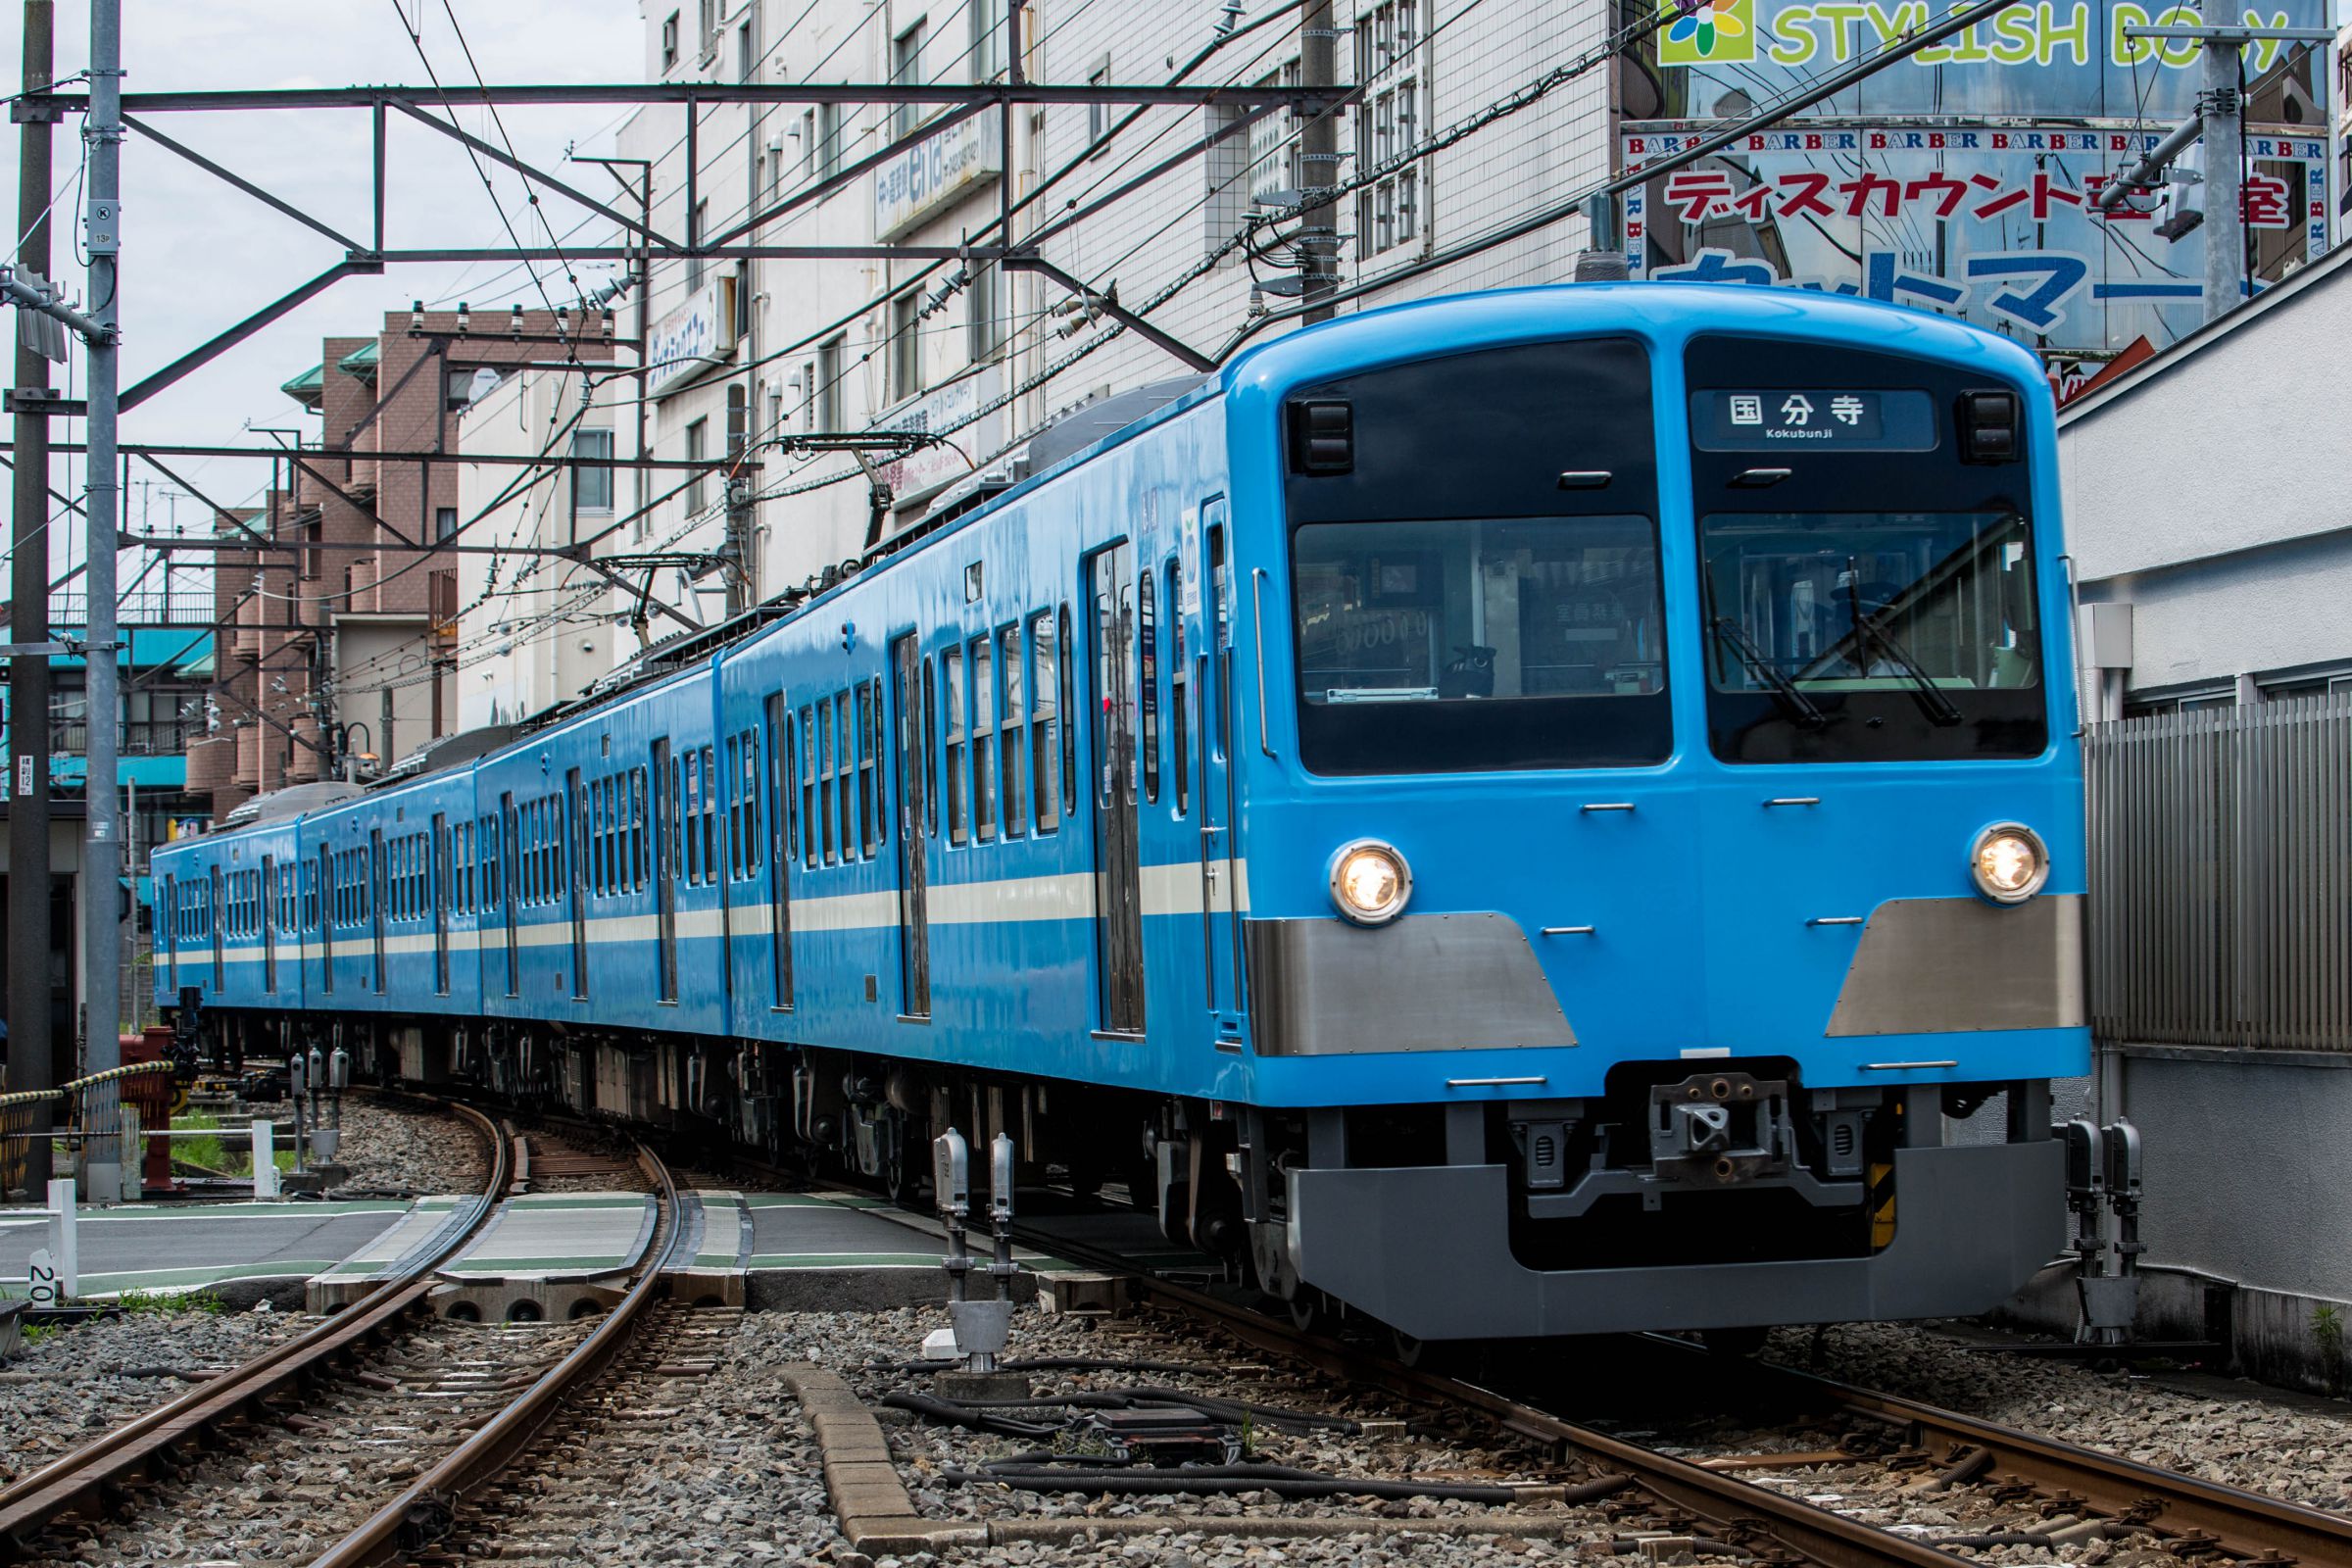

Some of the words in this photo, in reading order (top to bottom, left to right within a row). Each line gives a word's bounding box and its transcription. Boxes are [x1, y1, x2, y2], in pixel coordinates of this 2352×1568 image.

[1769, 3, 2088, 65] STYLISH
[2112, 5, 2287, 73] BOY
[1629, 136, 1735, 154] BARB
[1748, 133, 1856, 150] BARBER
[1870, 133, 1979, 149] BARBER
[1992, 133, 2098, 150] BARBER
[2245, 139, 2323, 159] ARBER
[2310, 168, 2325, 256] ARBER
[1730, 394, 1864, 425] 国分寺
[1766, 428, 1833, 439] Kokubunji
[30, 1265, 55, 1302] 20
